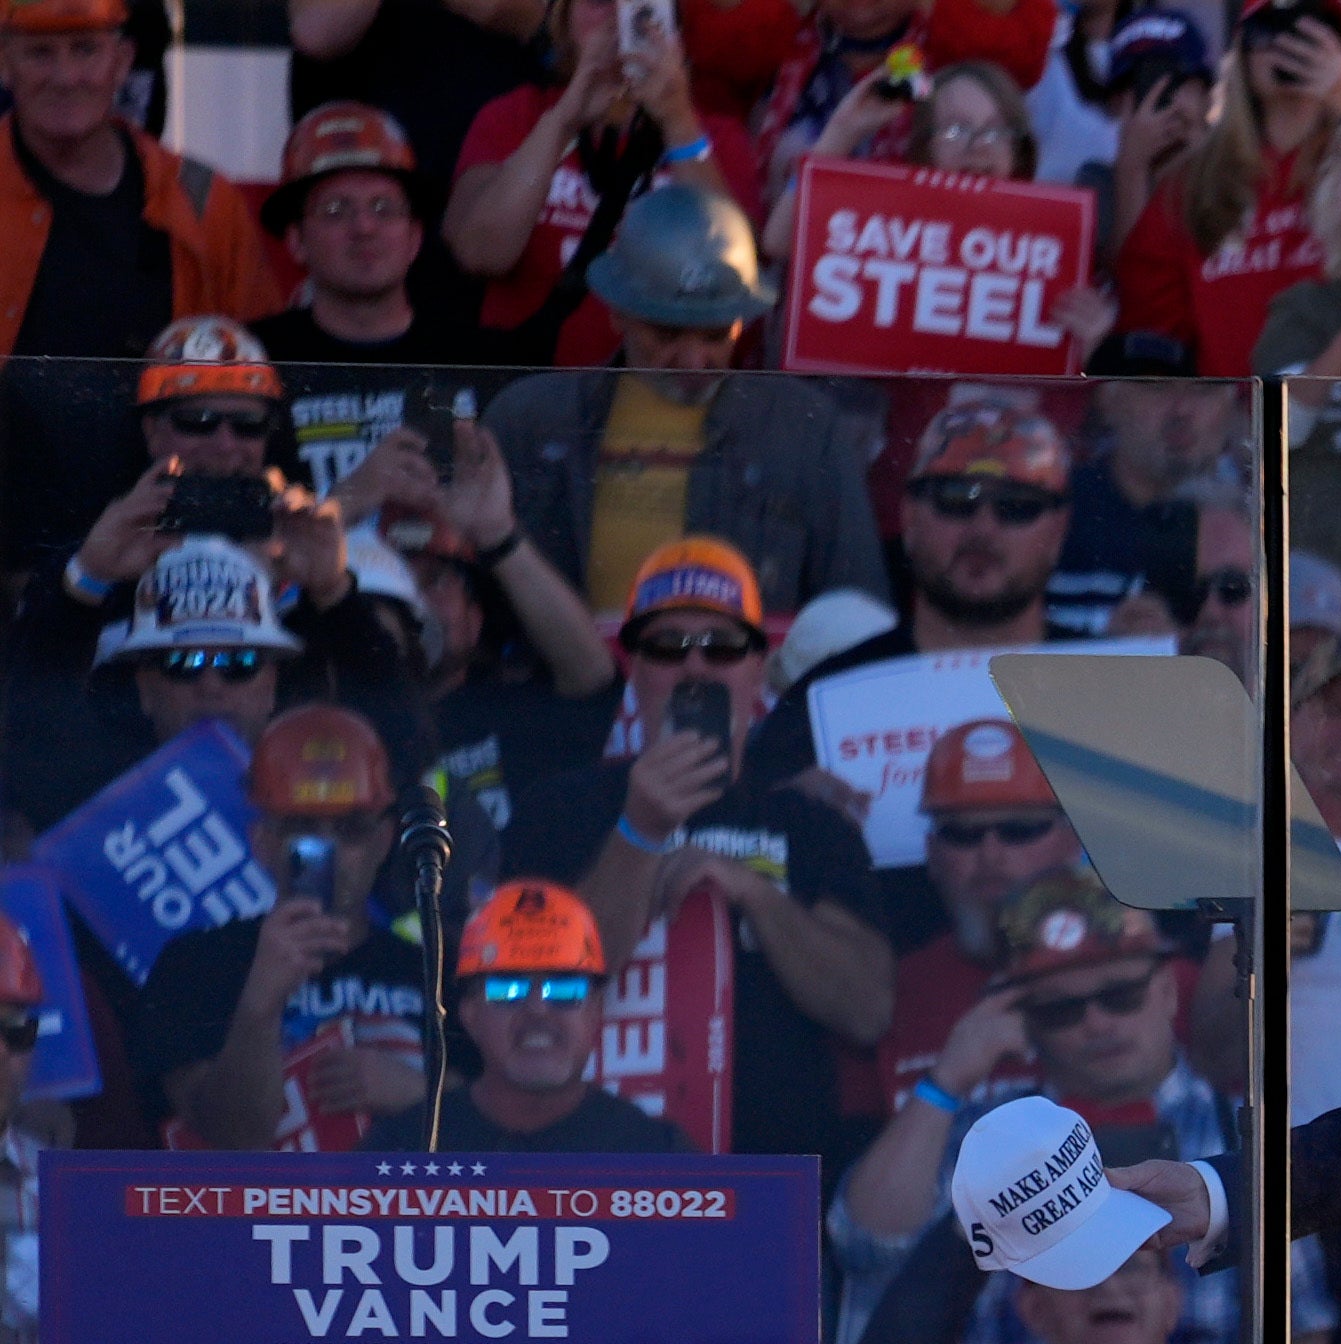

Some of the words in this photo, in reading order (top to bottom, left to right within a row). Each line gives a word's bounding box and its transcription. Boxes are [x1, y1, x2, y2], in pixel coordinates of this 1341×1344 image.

[827, 208, 952, 264] SAVE
[959, 226, 1064, 280] OUR
[808, 252, 1065, 349] STEEL
[103, 820, 192, 930] OUR
[135, 1187, 232, 1215] TEXT
[243, 1188, 539, 1218] PENNSYLVANIA
[548, 1189, 599, 1217] TO
[610, 1190, 727, 1219] 88022
[989, 1166, 1051, 1219] MAKE
[1021, 1184, 1083, 1237] GREAT
[1076, 1150, 1104, 1199] AGAI
[252, 1224, 611, 1287] TRUMP
[294, 1288, 570, 1339] VANCE
